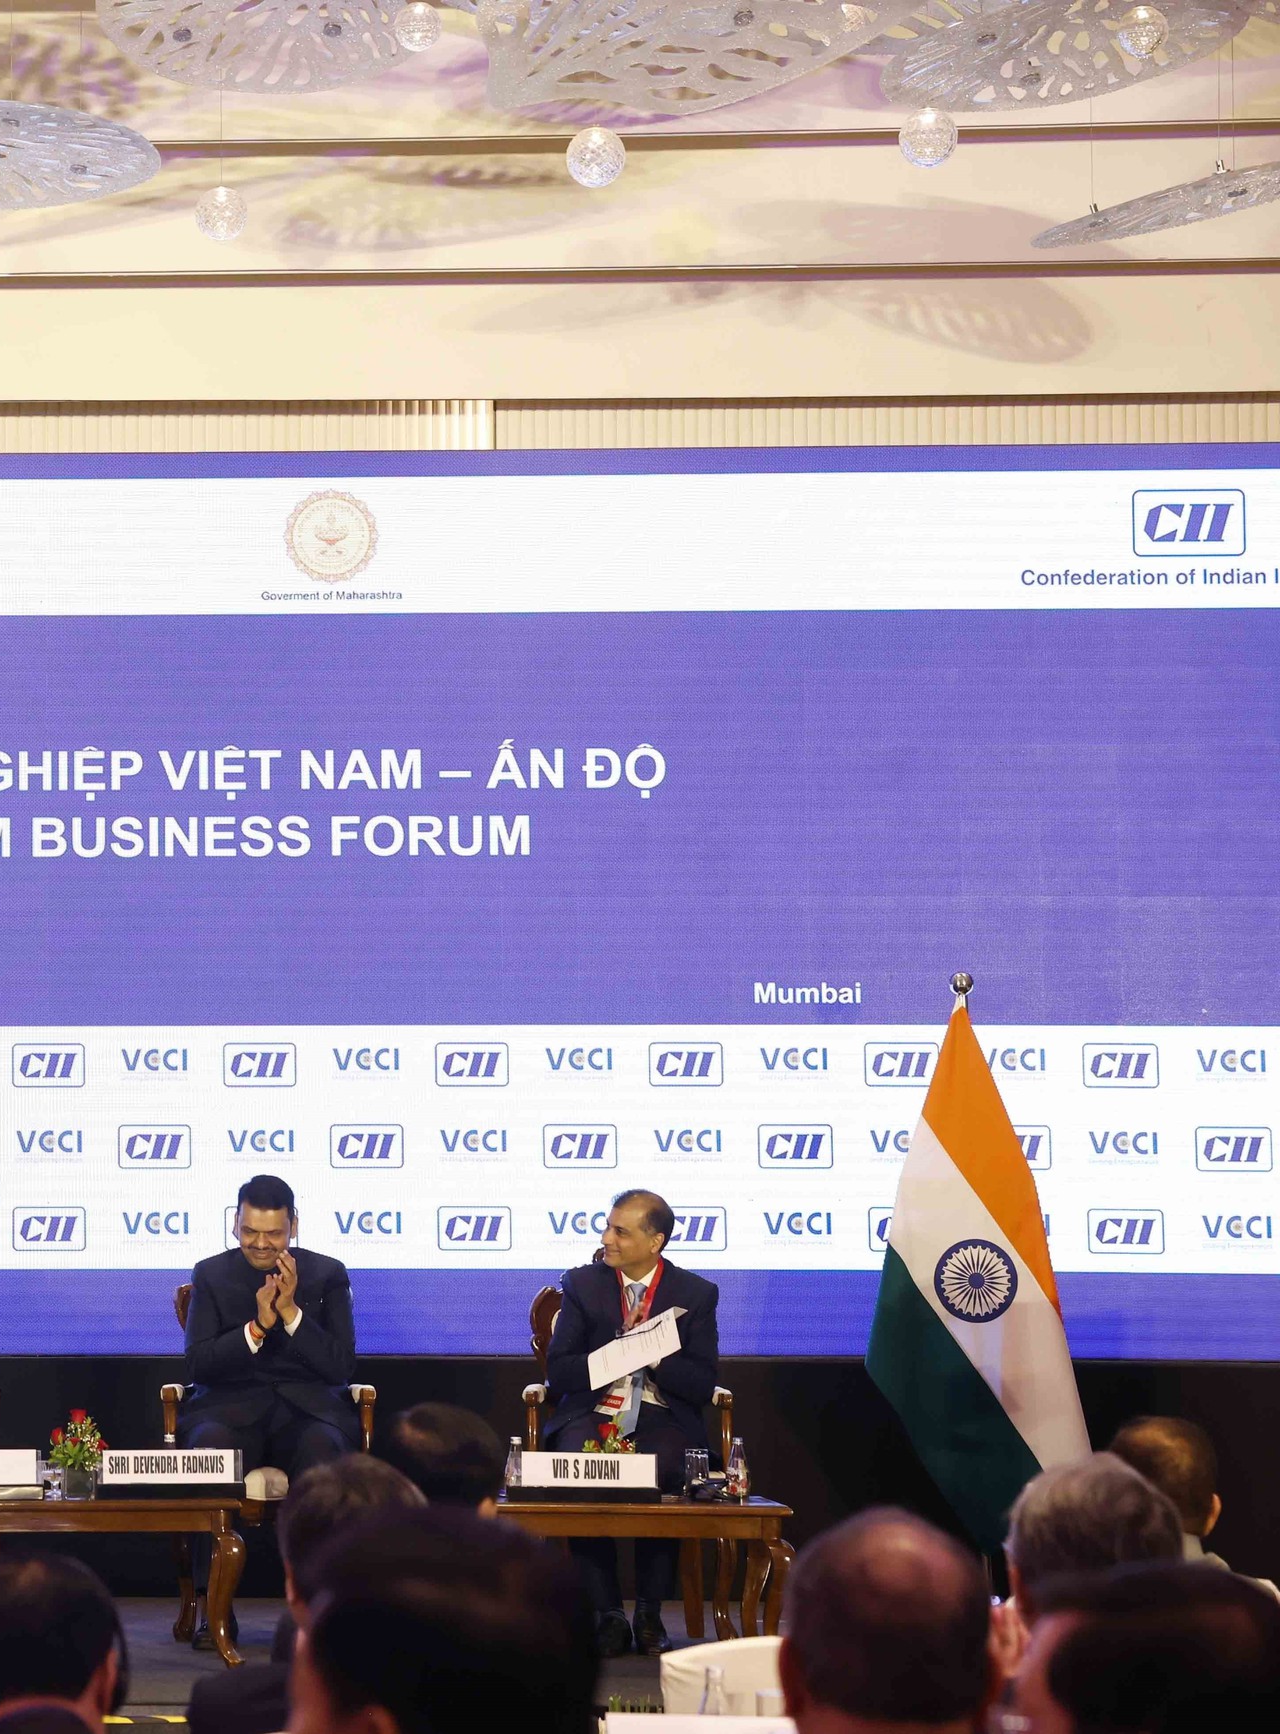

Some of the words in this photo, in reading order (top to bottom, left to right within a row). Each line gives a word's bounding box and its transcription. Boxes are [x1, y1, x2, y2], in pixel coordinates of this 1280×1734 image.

[1143, 503, 1235, 543] CII
[1020, 568, 1169, 586] Confederation
[1175, 568, 1196, 585] of
[1202, 568, 1267, 585] Indian
[322, 591, 333, 601] of
[335, 591, 403, 600] Maharashtra
[158, 745, 282, 801] VIỆT
[300, 748, 422, 790] NAM
[486, 738, 564, 789] ẤN
[582, 743, 666, 799] ĐỘ
[32, 816, 311, 858] BUSINESS
[331, 815, 530, 857] FORUM
[754, 982, 861, 1005] Mumbai
[20, 1053, 77, 1078] CII
[122, 1049, 188, 1071] VCCI
[231, 1052, 289, 1077] CII
[333, 1048, 399, 1070] VCCI
[443, 1052, 501, 1077] CII
[546, 1048, 612, 1070] VCCI
[656, 1051, 715, 1077] CII
[760, 1048, 827, 1070] VCCI
[872, 1052, 931, 1078] CII
[1090, 1053, 1150, 1078] CII
[1197, 1050, 1267, 1073] VCCI
[17, 1130, 83, 1152] VCCI
[126, 1134, 184, 1160] CII
[228, 1130, 294, 1152] VCCI
[337, 1134, 396, 1159] CII
[440, 1130, 506, 1152] VCCI
[551, 1134, 609, 1159] CII
[654, 1130, 721, 1152] VCCI
[766, 1134, 825, 1159] CII
[1089, 1132, 1158, 1154] VCCI
[1204, 1136, 1264, 1162] CII
[20, 1216, 78, 1241] CII
[123, 1212, 189, 1234] VCCI
[335, 1211, 401, 1234] VCCI
[445, 1216, 503, 1241] CII
[548, 1212, 606, 1234] VCC
[764, 1212, 832, 1235] VCCI
[1096, 1218, 1156, 1245] CII
[1202, 1216, 1273, 1238] VCCI
[108, 1456, 130, 1475] SHRI
[133, 1456, 178, 1475] DEVENDRA
[182, 1455, 224, 1474] FADNAVIS
[552, 1458, 569, 1479] VIR
[573, 1458, 580, 1480] S
[583, 1459, 620, 1480] ADVANI
